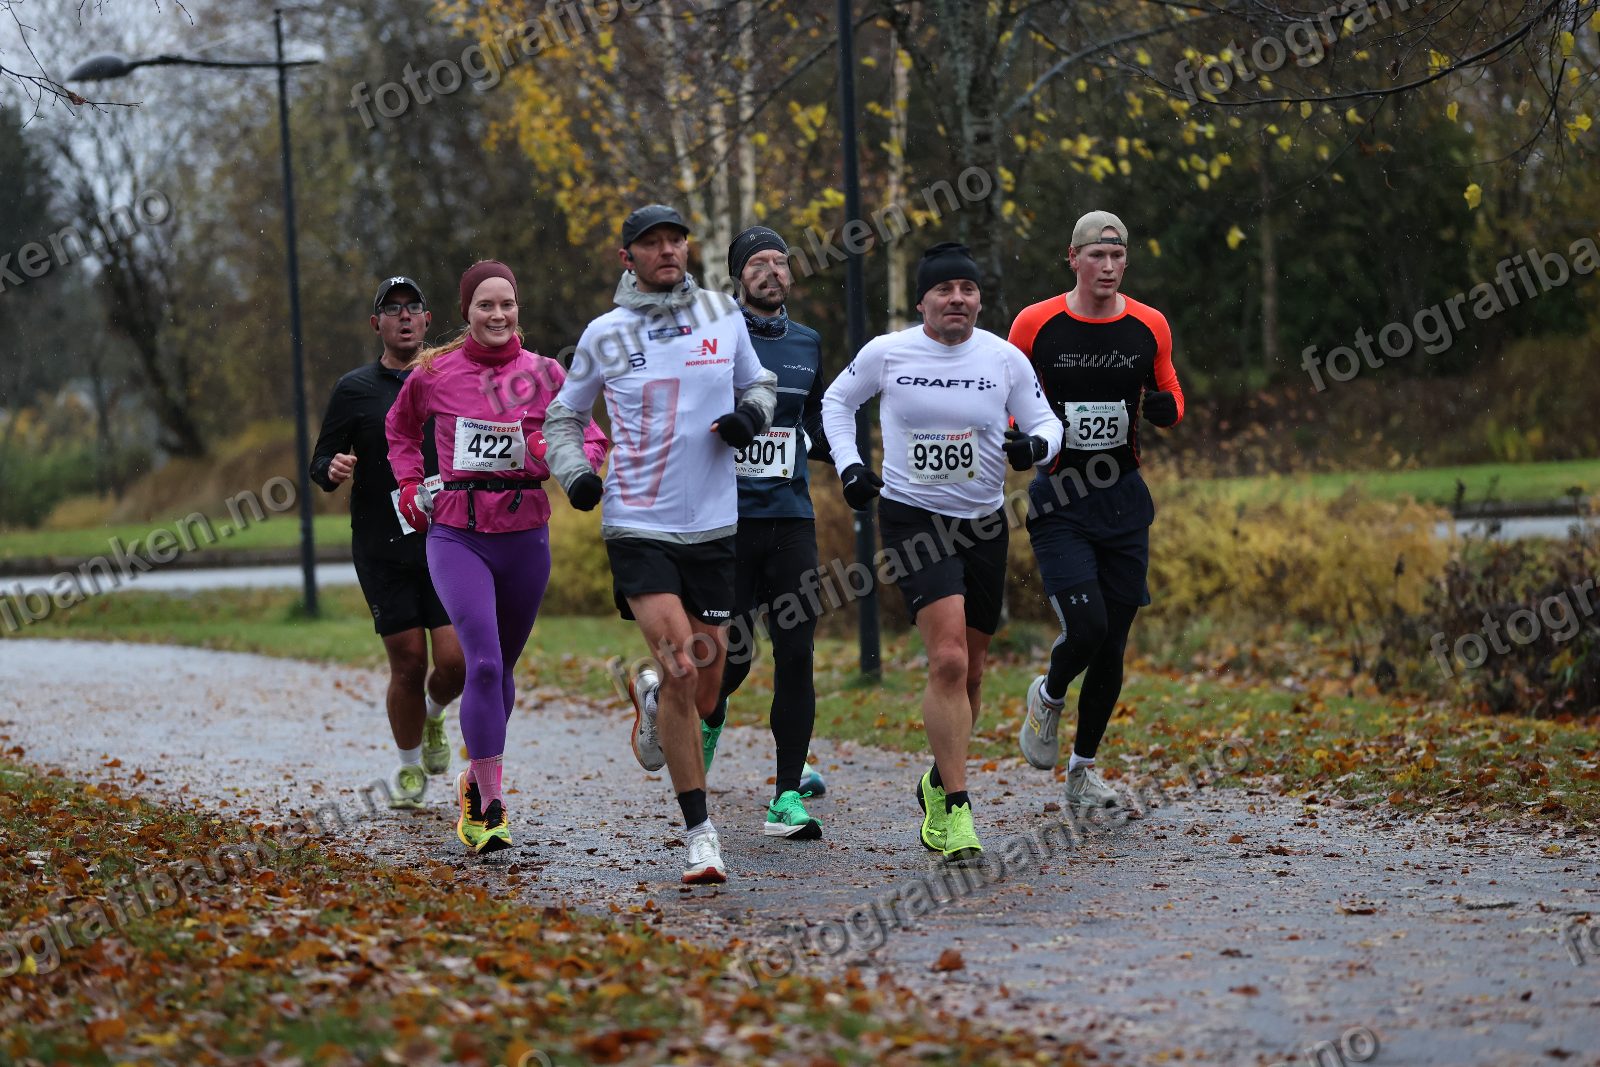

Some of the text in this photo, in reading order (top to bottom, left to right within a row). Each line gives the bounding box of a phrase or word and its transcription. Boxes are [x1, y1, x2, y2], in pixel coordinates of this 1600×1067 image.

[896, 376, 975, 389] CRAFT
[462, 421, 521, 433] NORGESTESTEN
[913, 431, 973, 441] NORGESTESTEN
[1078, 416, 1119, 440] 525
[467, 433, 512, 459] 422
[734, 440, 786, 466] 3001
[913, 442, 973, 471] 9369
